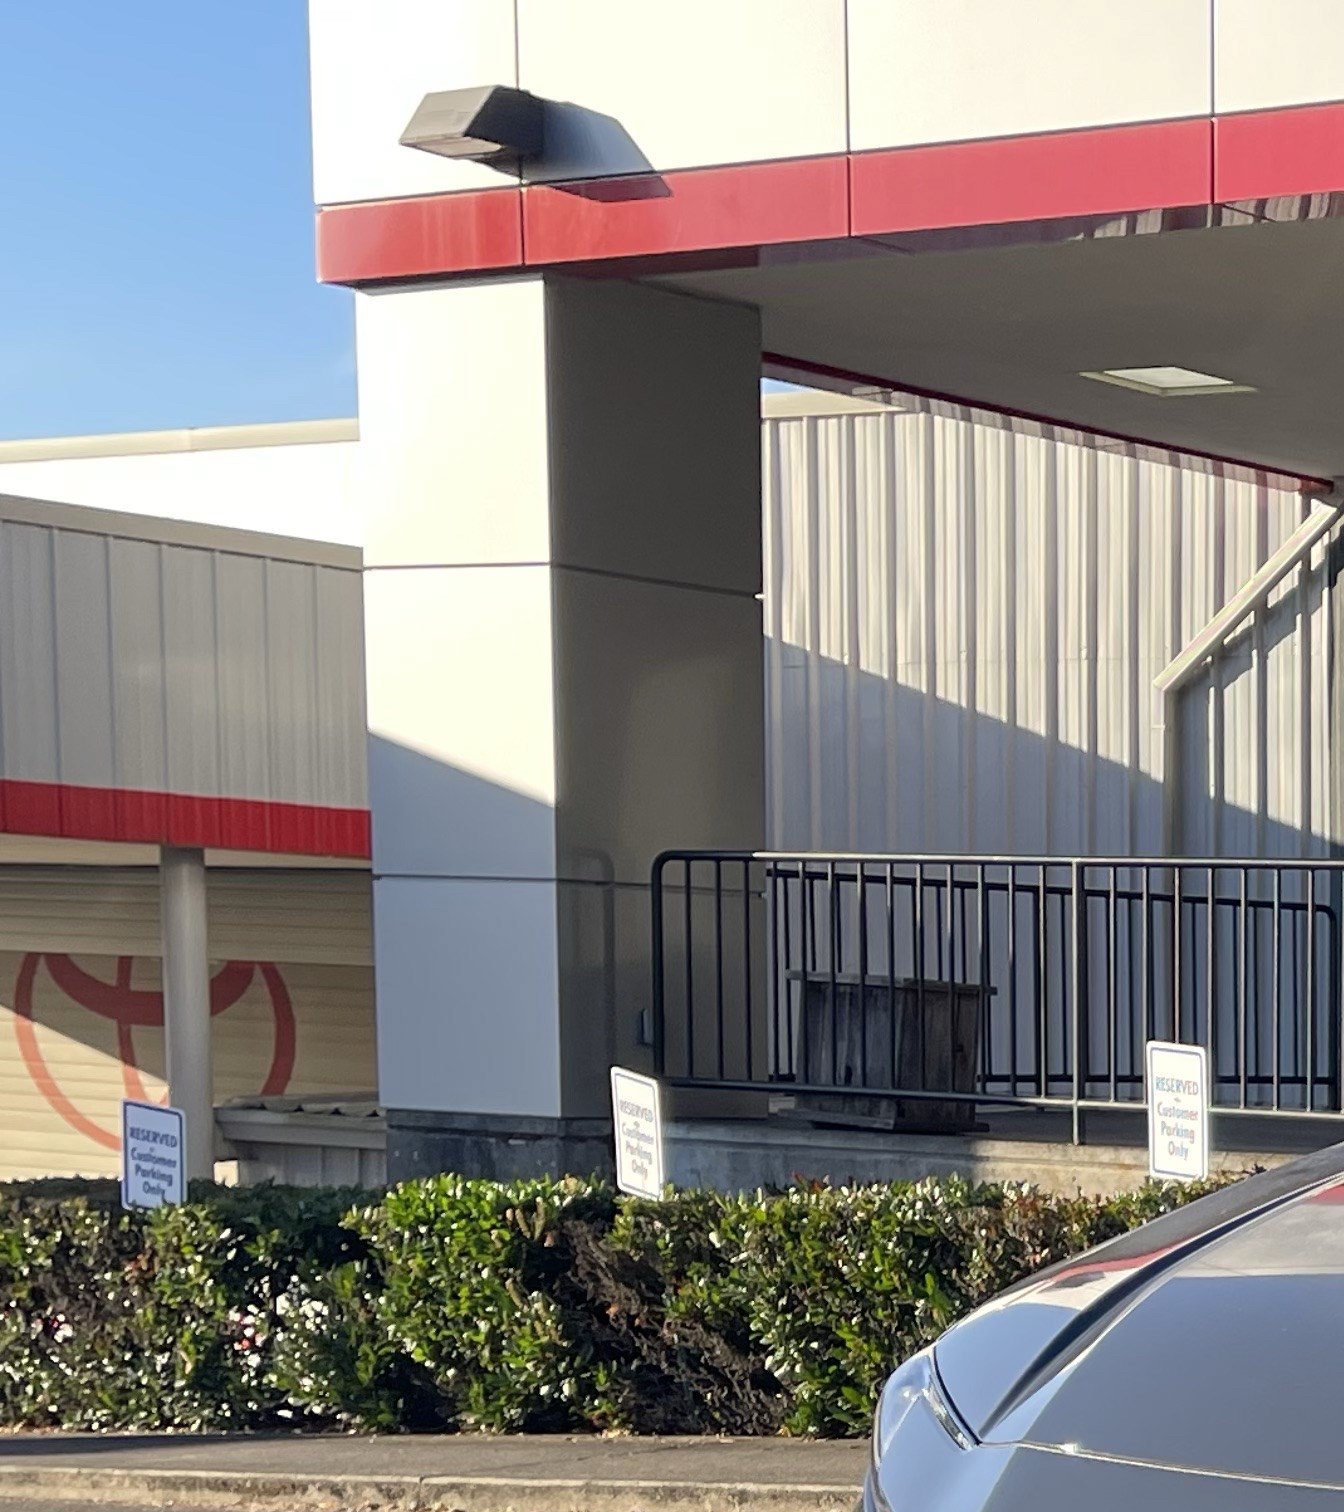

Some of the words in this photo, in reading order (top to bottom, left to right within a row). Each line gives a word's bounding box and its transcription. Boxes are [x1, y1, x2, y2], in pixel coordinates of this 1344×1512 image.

[1155, 1075, 1199, 1096] RESERVED
[619, 1099, 654, 1123] RESERVED
[1157, 1101, 1199, 1121] Customer
[129, 1126, 178, 1148] RESERVED
[622, 1122, 654, 1145] Customer
[1160, 1120, 1195, 1145] Parking
[130, 1147, 177, 1169] Customer
[625, 1140, 653, 1165] Parking
[1167, 1141, 1189, 1161] Only
[134, 1163, 173, 1187] Parking
[631, 1159, 649, 1181] Only
[142, 1180, 166, 1198] Only
